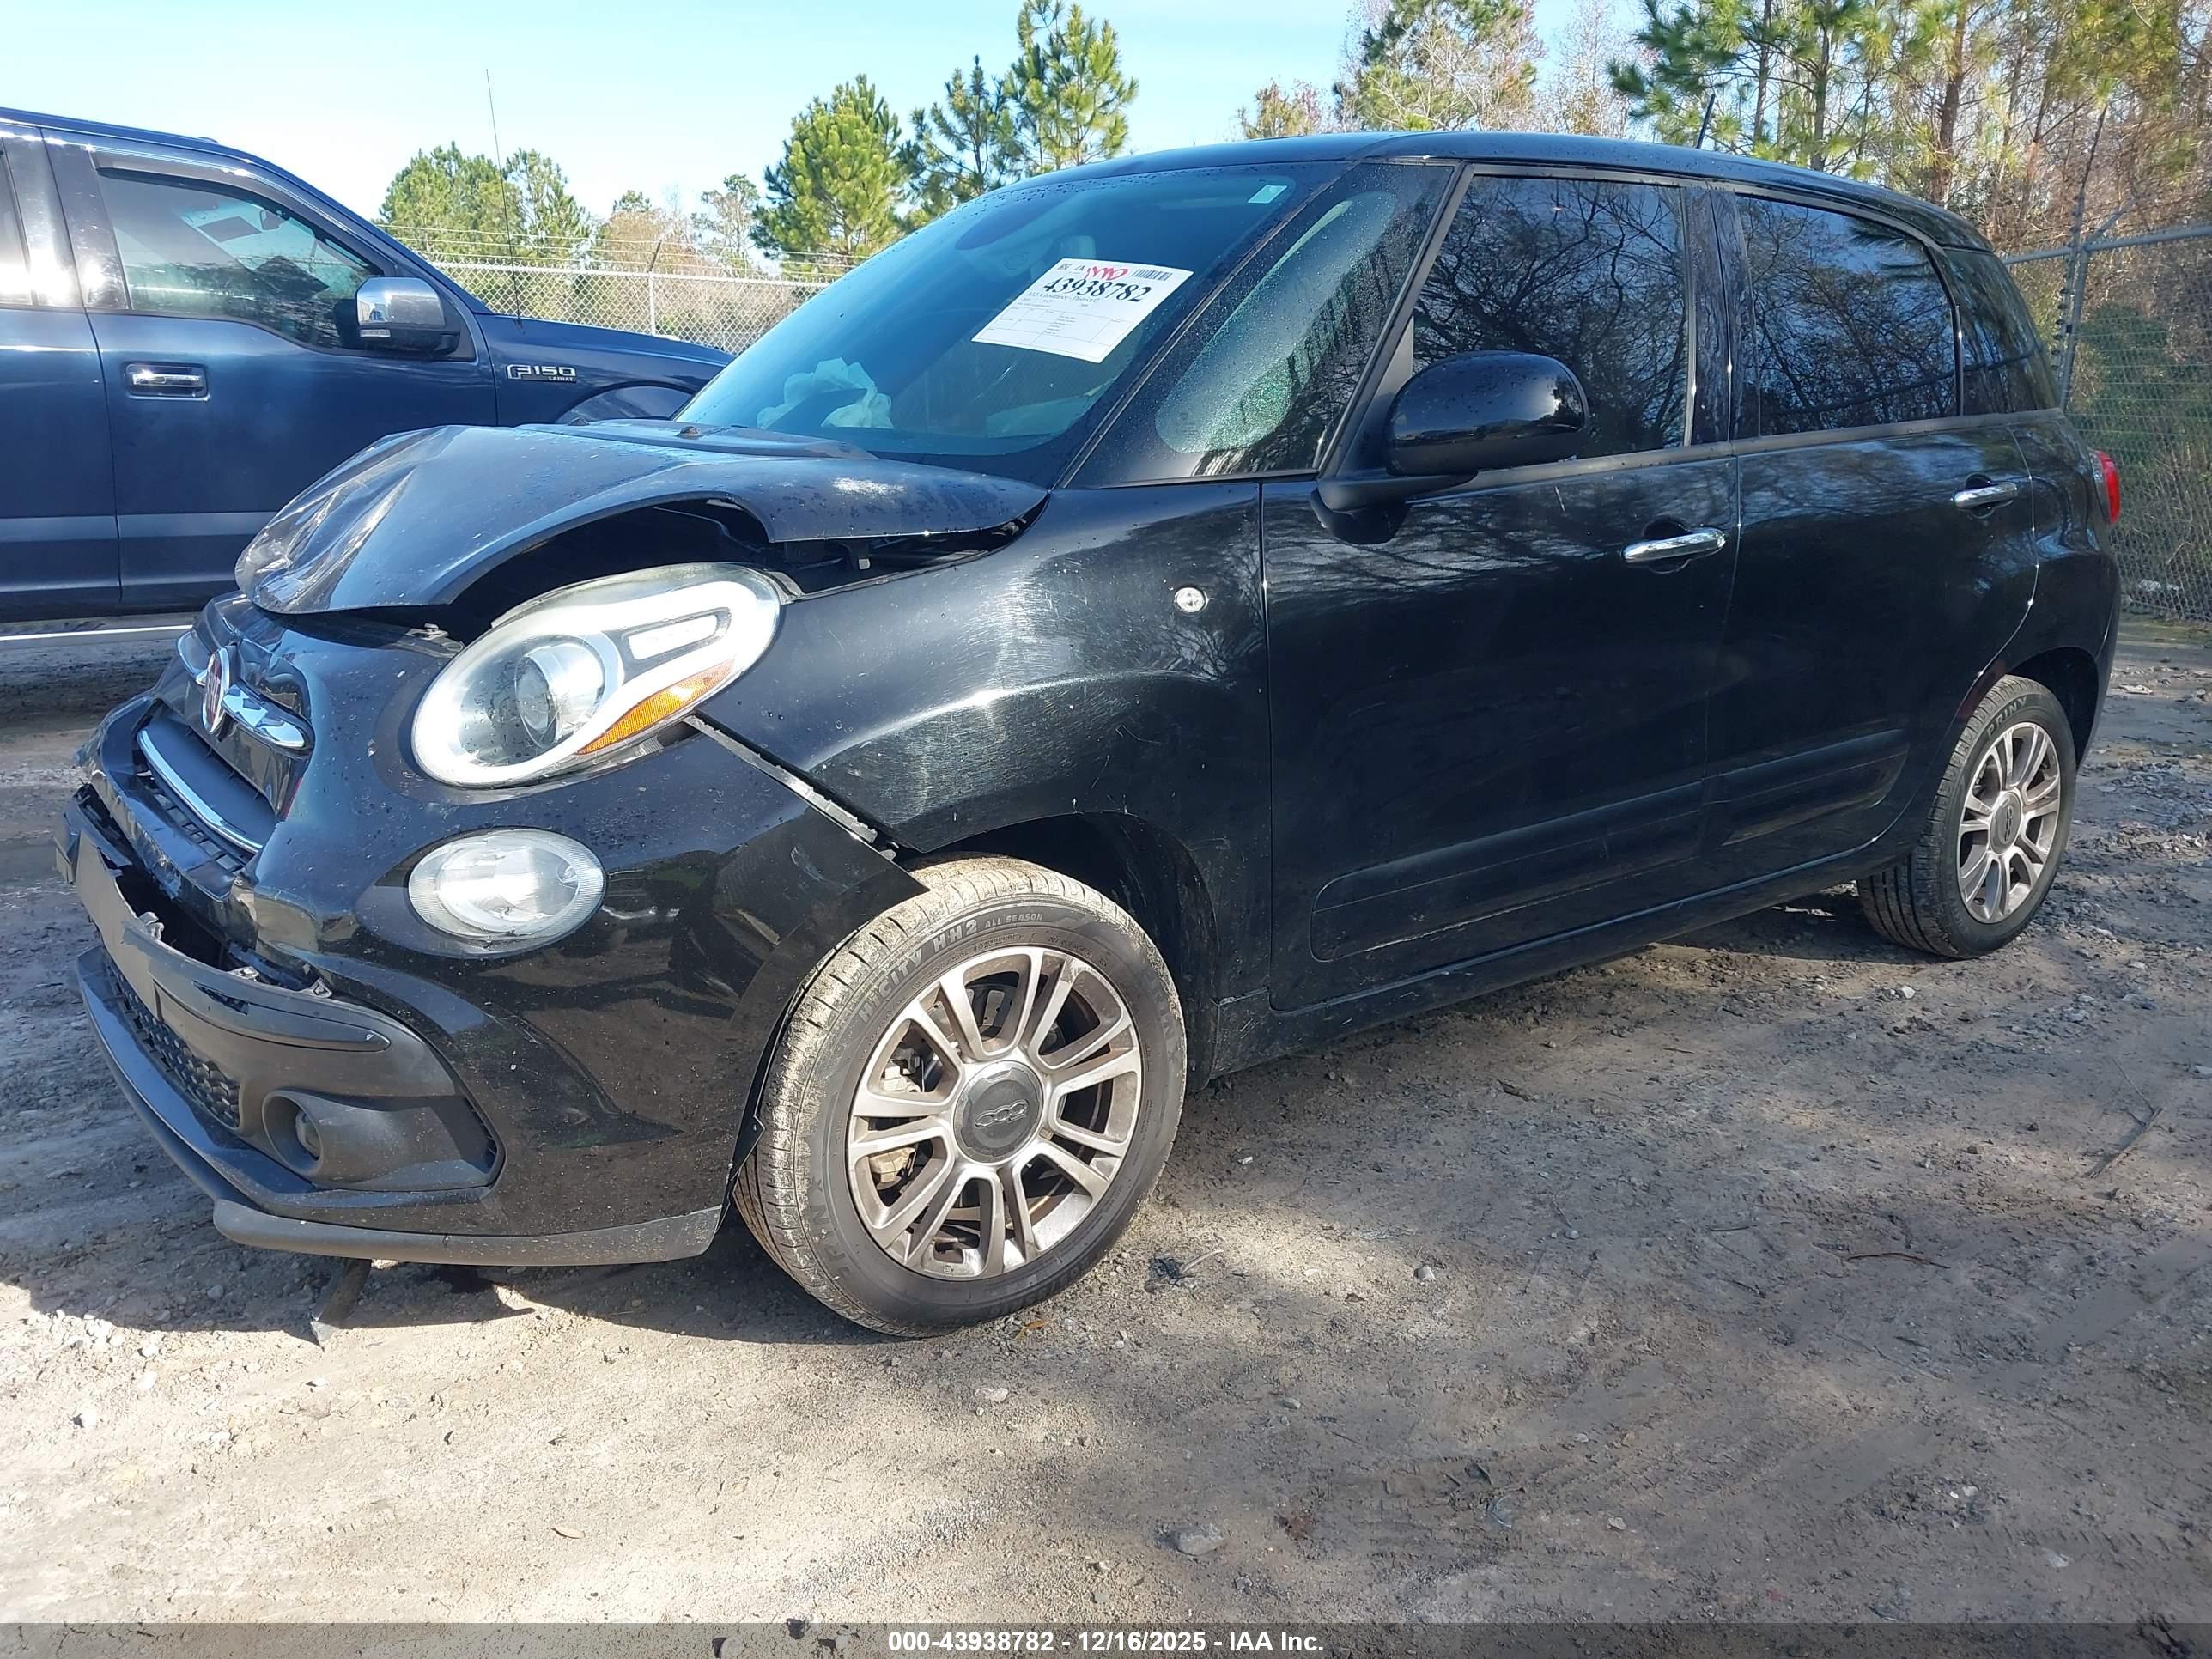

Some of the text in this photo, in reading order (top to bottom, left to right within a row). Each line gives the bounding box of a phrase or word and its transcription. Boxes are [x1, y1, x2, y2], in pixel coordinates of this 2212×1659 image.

[1044, 276, 1152, 302] 43938782
[507, 363, 576, 380] F150
[859, 913, 1044, 1024] HICITY HH2 ALL SEASON
